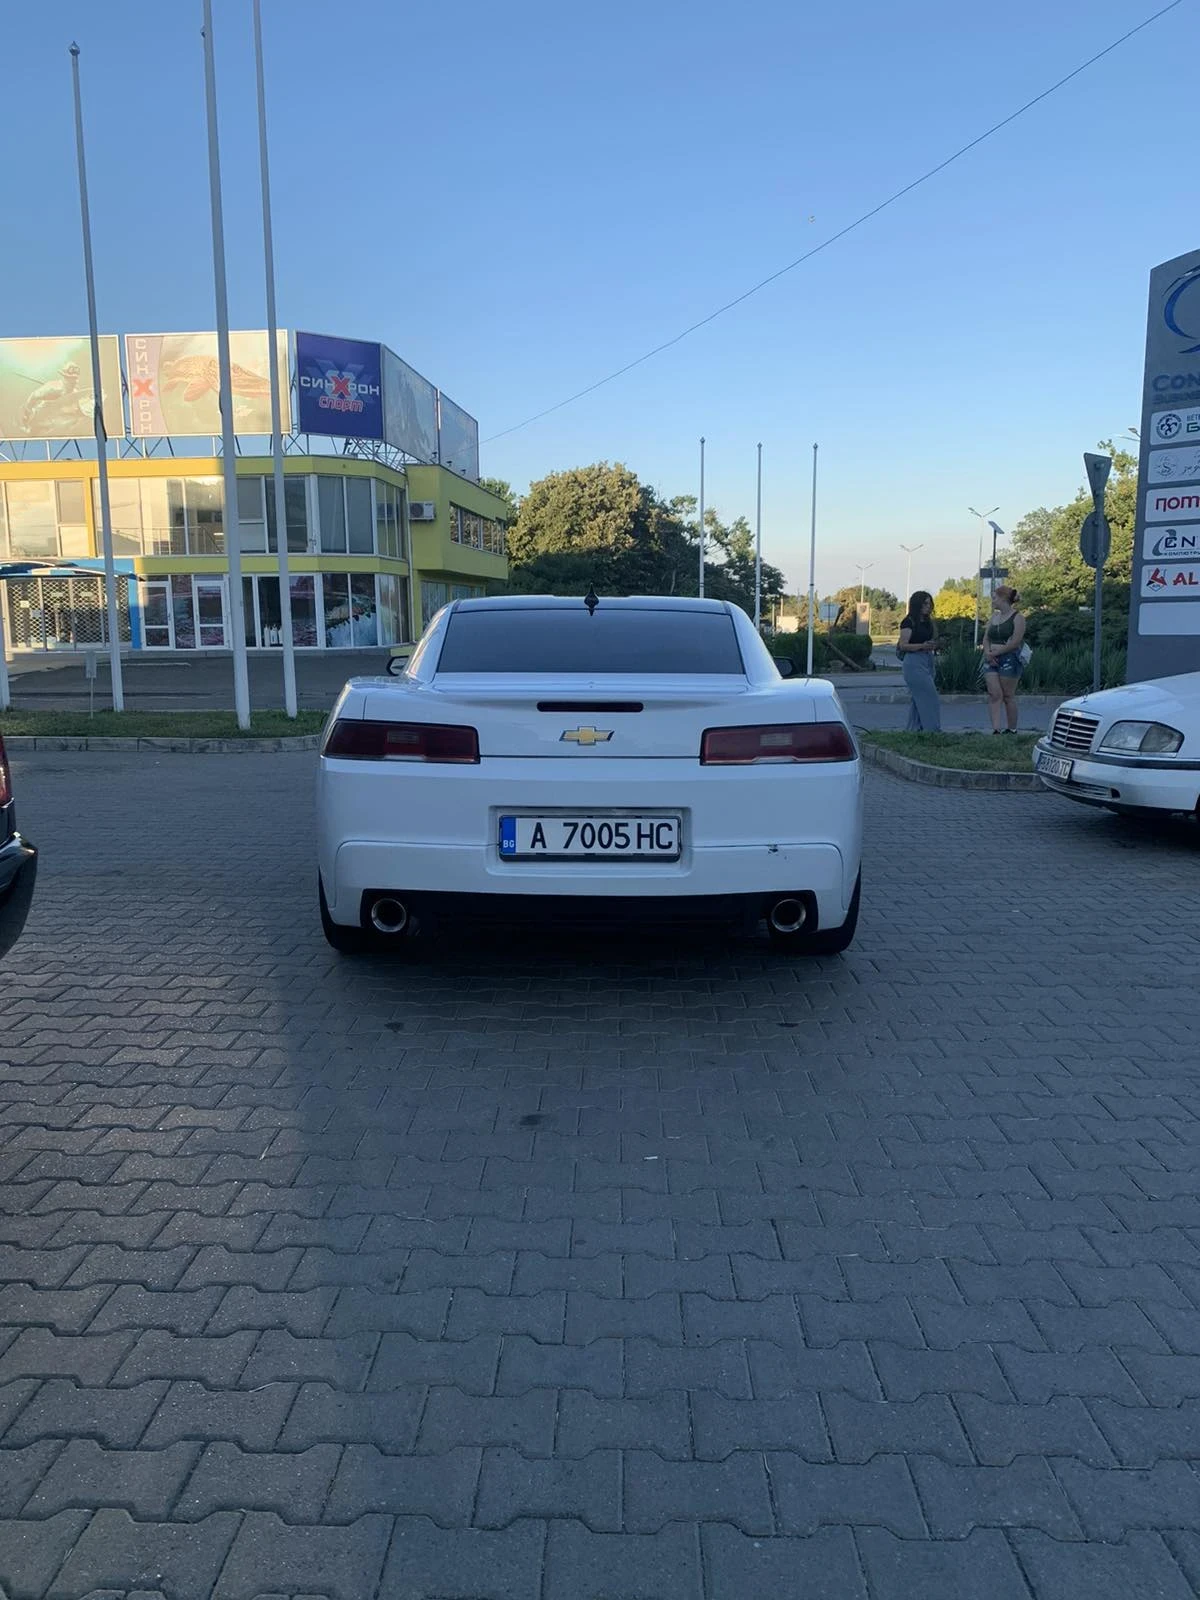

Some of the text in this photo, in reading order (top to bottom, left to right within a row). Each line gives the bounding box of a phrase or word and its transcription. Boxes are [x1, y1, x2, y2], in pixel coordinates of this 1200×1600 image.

[300, 374, 380, 398] СИНХРОН
[503, 839, 515, 848] BG
[530, 822, 547, 849] A
